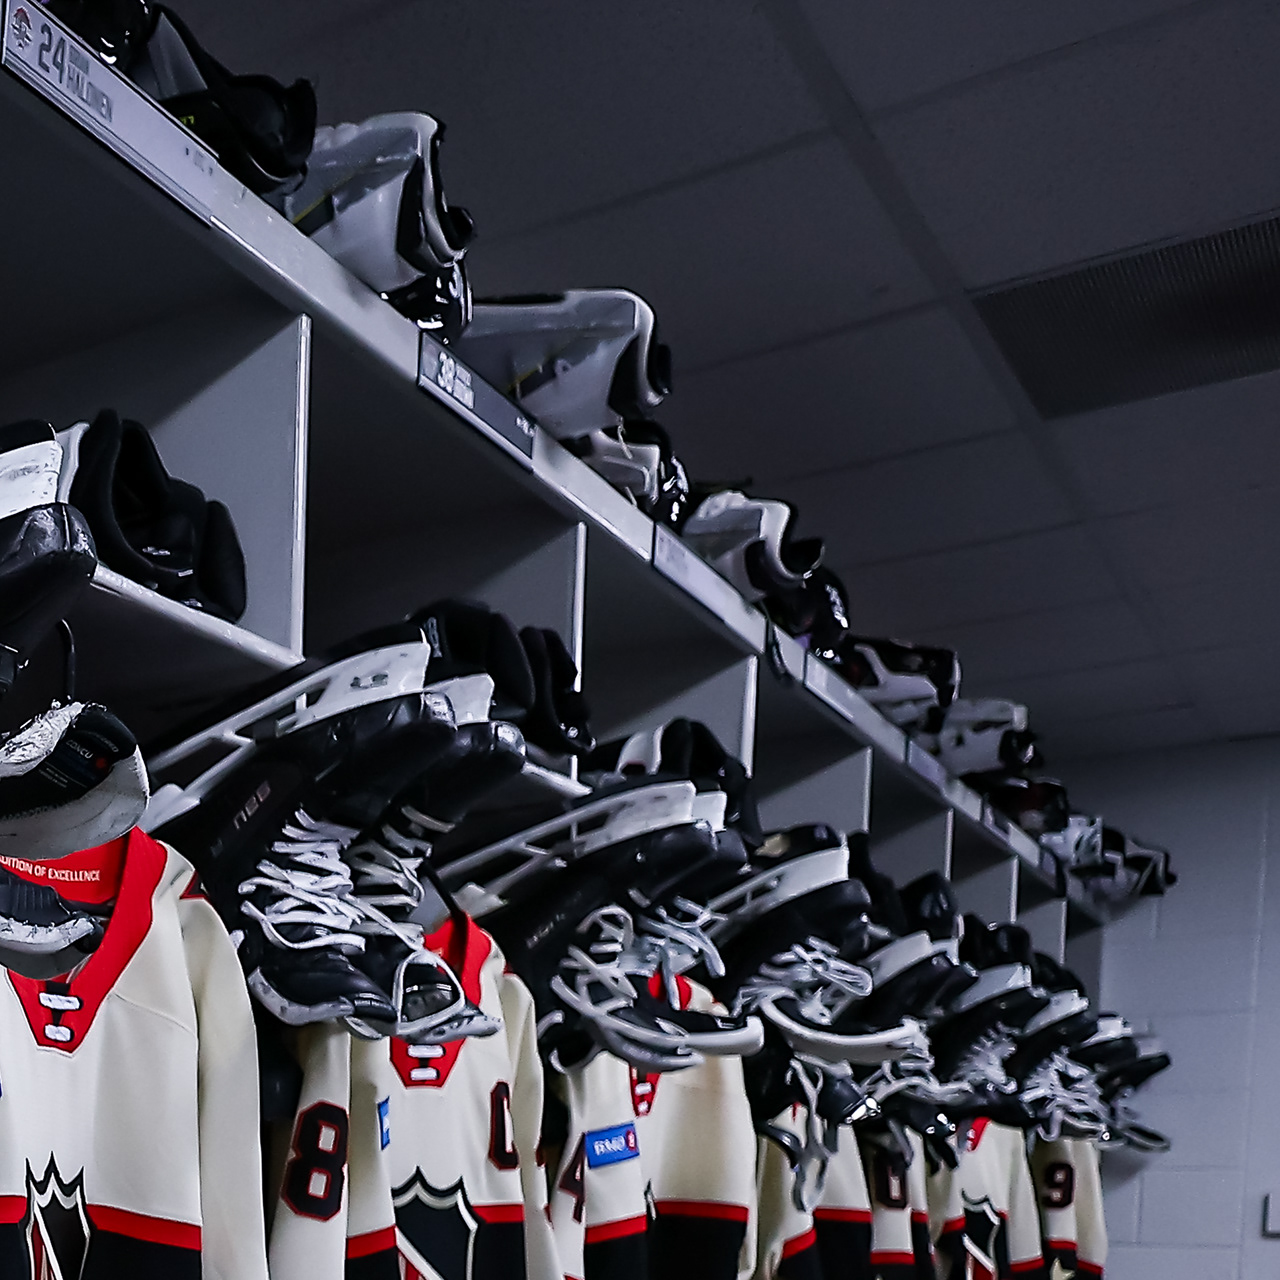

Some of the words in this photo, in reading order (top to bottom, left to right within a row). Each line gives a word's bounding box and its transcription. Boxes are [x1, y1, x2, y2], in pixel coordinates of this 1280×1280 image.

[38, 22, 66, 85] 24
[34, 865, 47, 877] OF
[47, 868, 101, 882] EXCELLENCE
[281, 1101, 350, 1222] 8
[1042, 1161, 1076, 1208] 9
